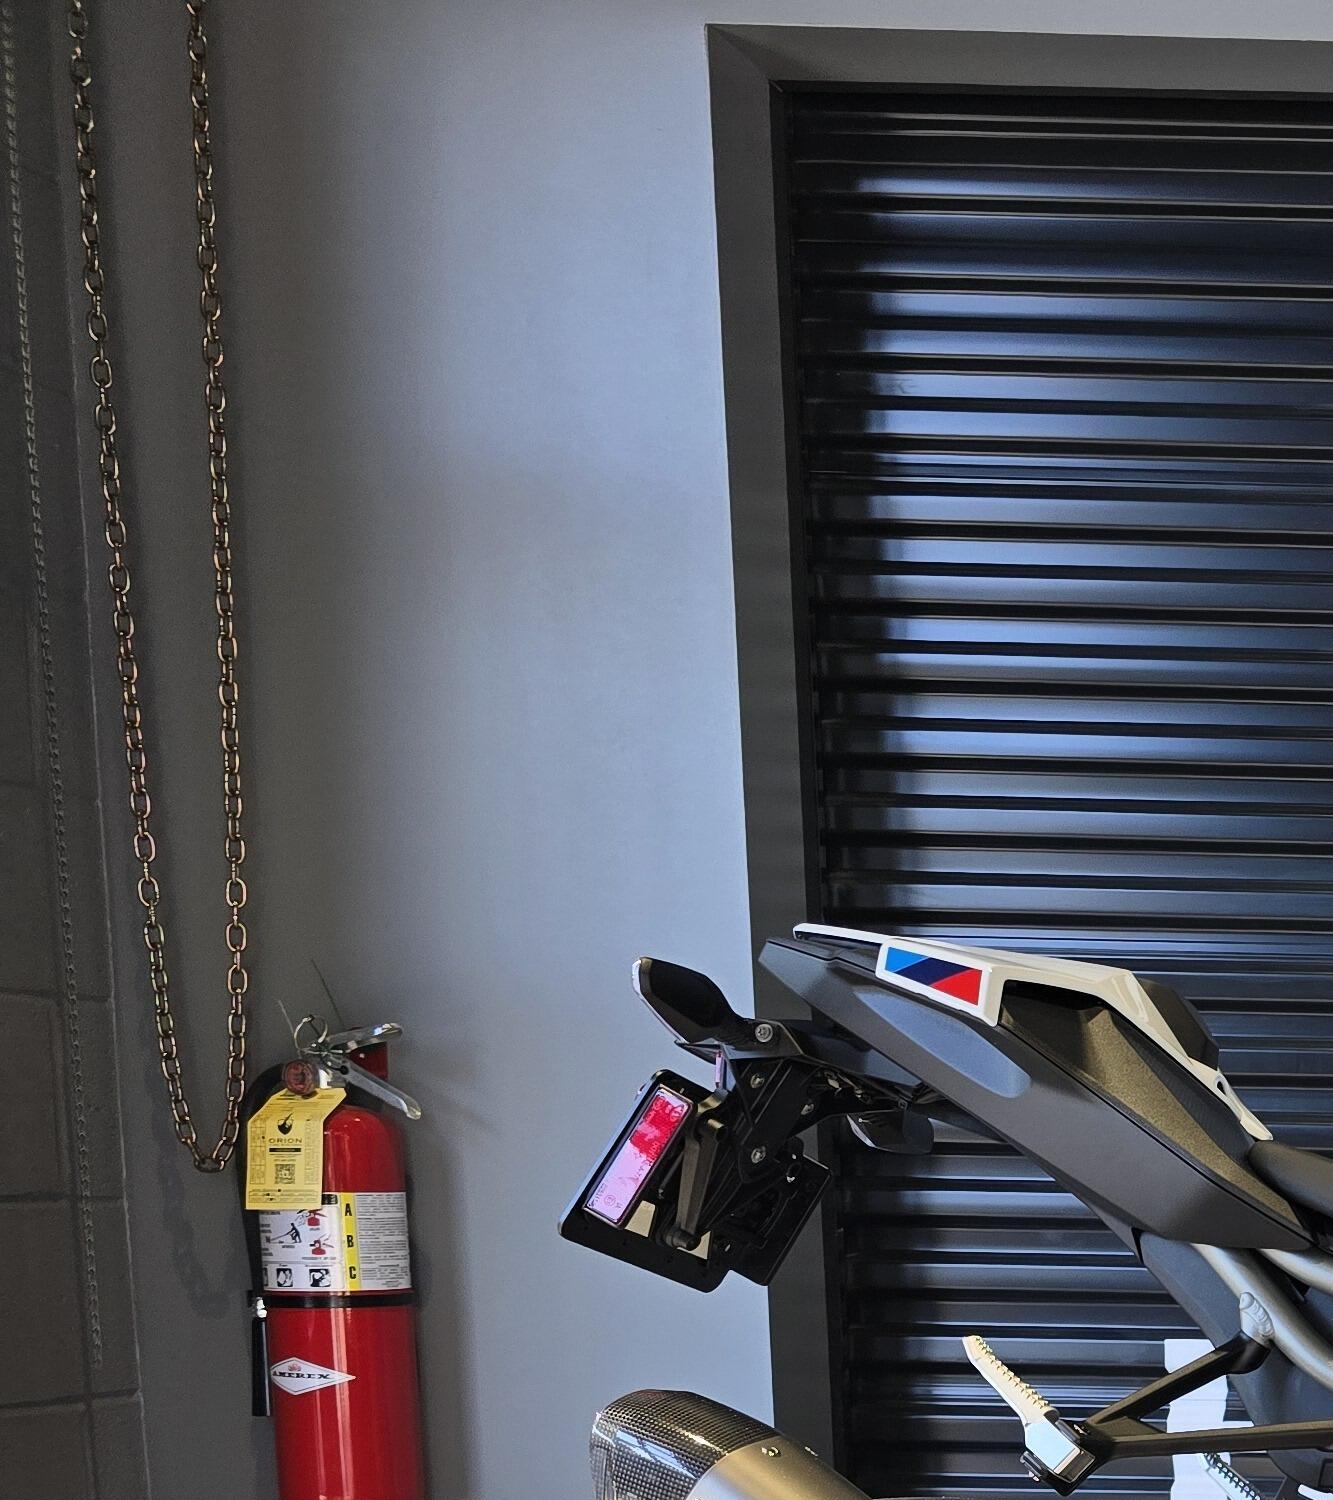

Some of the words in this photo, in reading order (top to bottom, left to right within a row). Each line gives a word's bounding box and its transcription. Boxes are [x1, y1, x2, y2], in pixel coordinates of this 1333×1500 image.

[344, 1203, 353, 1217] A
[346, 1234, 354, 1248] B
[348, 1266, 357, 1280] C
